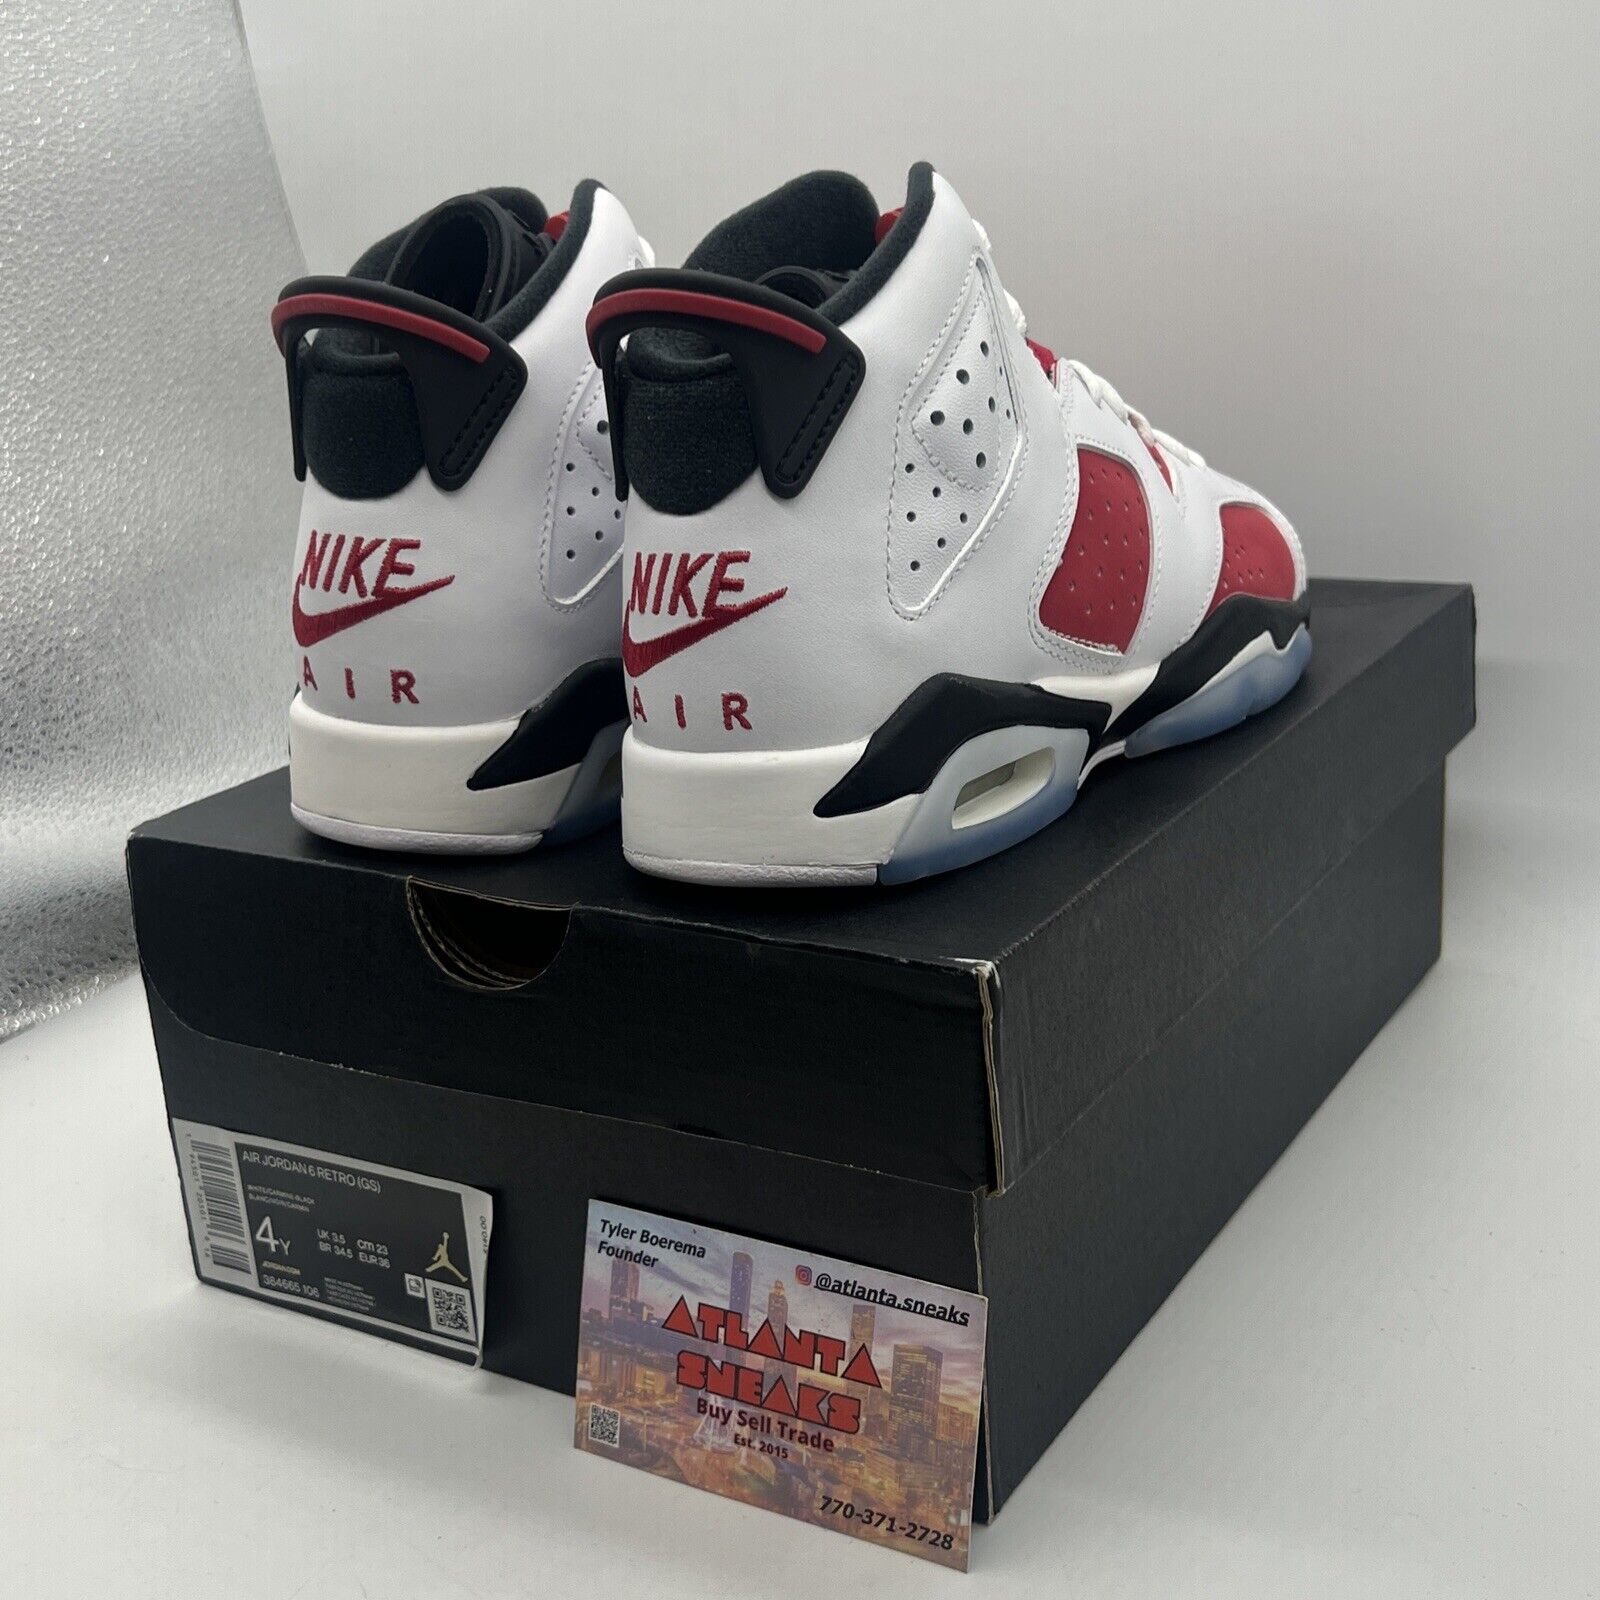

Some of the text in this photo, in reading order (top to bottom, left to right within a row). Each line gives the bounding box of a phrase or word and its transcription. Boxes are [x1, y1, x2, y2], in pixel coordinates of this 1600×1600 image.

[302, 530, 420, 597] NIKE
[629, 550, 750, 618] NIKE
[302, 656, 420, 704] AIR
[632, 686, 753, 731] AIR
[242, 1151, 382, 1194] AIR JORDAN 6 RETRO (GS)
[316, 1228, 330, 1240] UK
[331, 1231, 346, 1245] 3.5
[376, 1243, 389, 1255] 23
[318, 1240, 332, 1252] BR
[358, 1251, 378, 1265] EUR
[597, 1240, 659, 1269] Founder
[599, 1219, 706, 1259] Tyler Boerema
[813, 1272, 971, 1328] @atlanta.sneaks
[661, 1294, 882, 1389] ATLANTA
[676, 1349, 862, 1435] SNEAKS
[696, 1396, 835, 1453] Buy Sell Trade
[733, 1434, 789, 1460] Est. 2015
[819, 1495, 955, 1551] 770-371-2728
